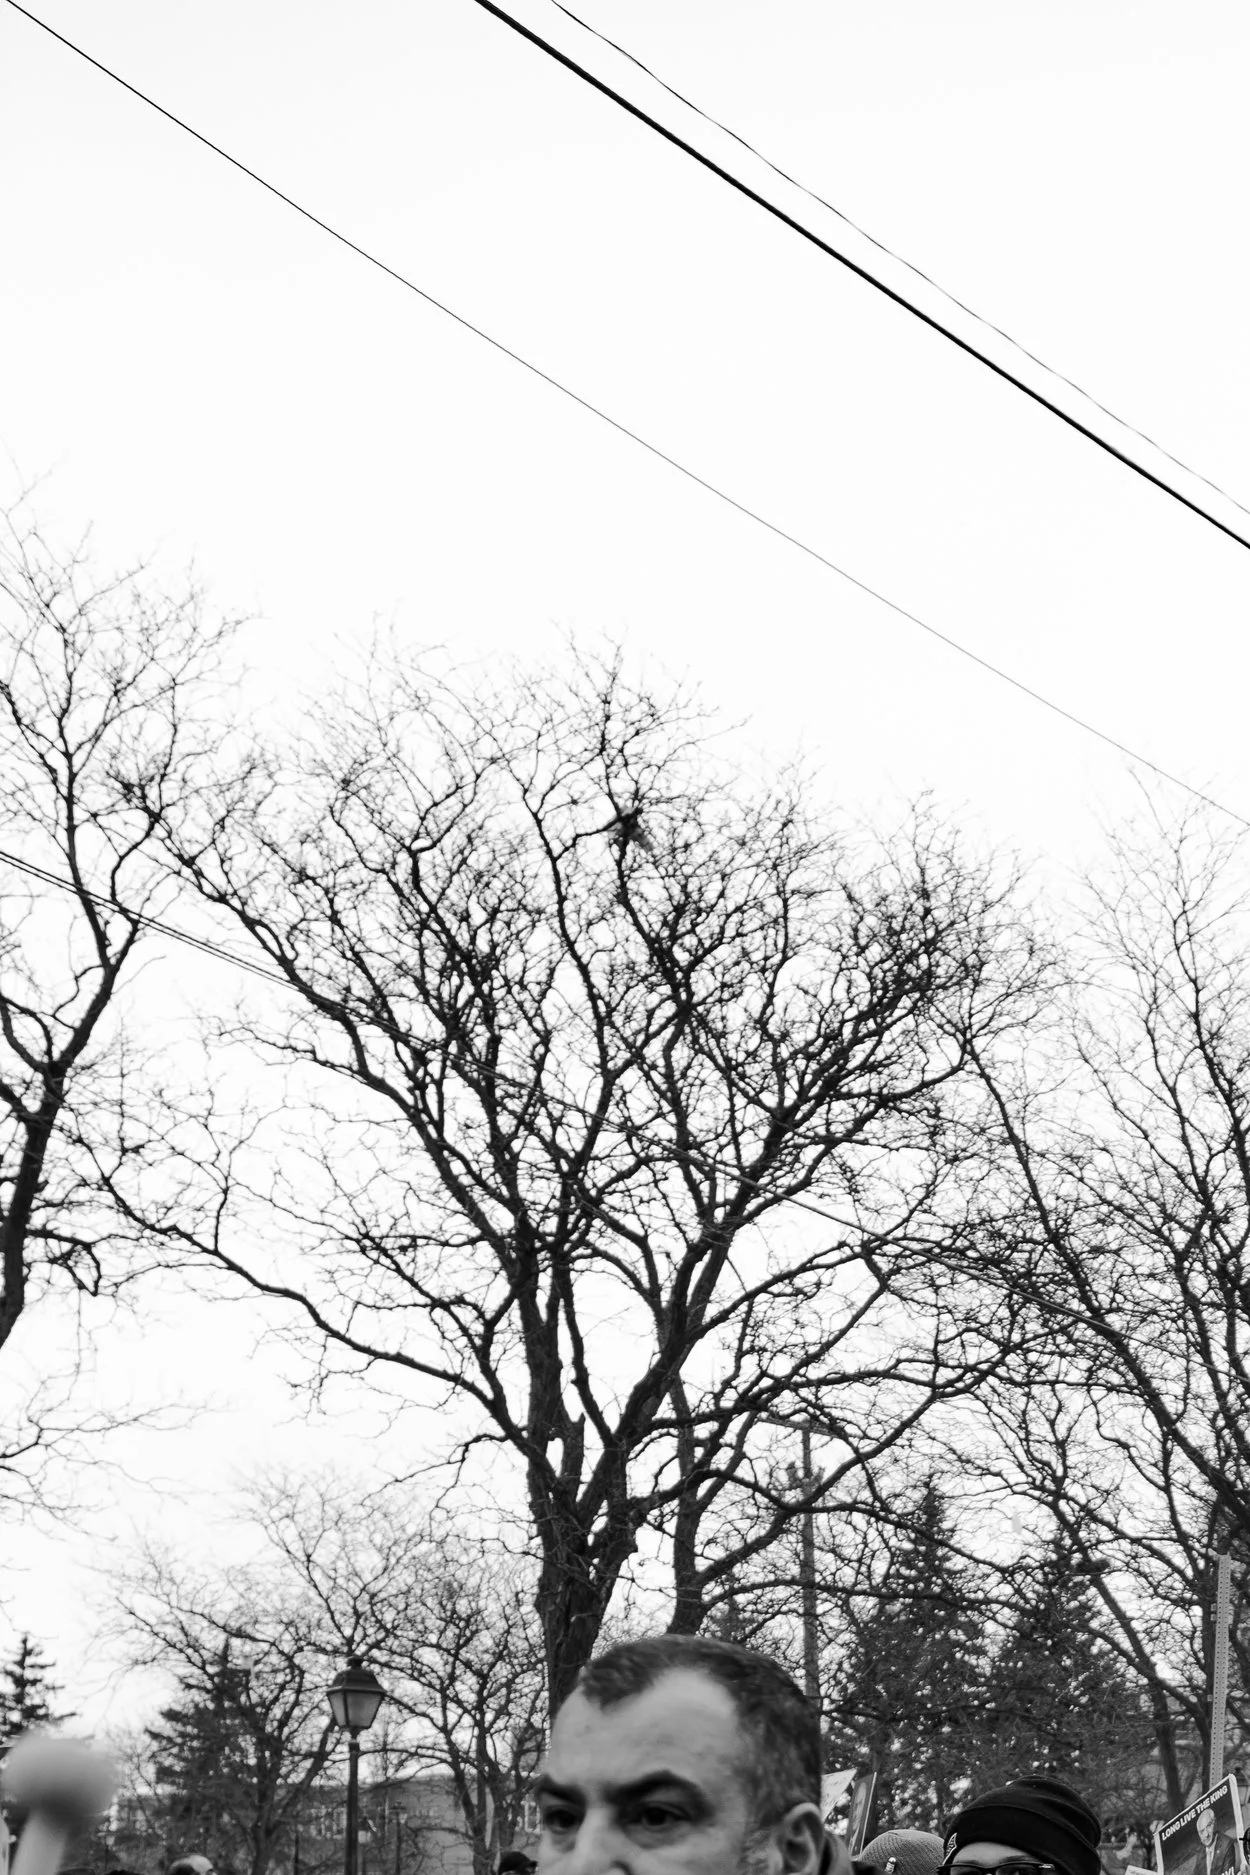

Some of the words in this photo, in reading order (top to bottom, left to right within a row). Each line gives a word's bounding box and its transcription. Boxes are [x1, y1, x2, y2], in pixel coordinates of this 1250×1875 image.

[1161, 1821, 1181, 1841] LONG
[1180, 1809, 1197, 1827] LIVE
[1195, 1797, 1211, 1814] THE
[1210, 1785, 1228, 1804] KING
